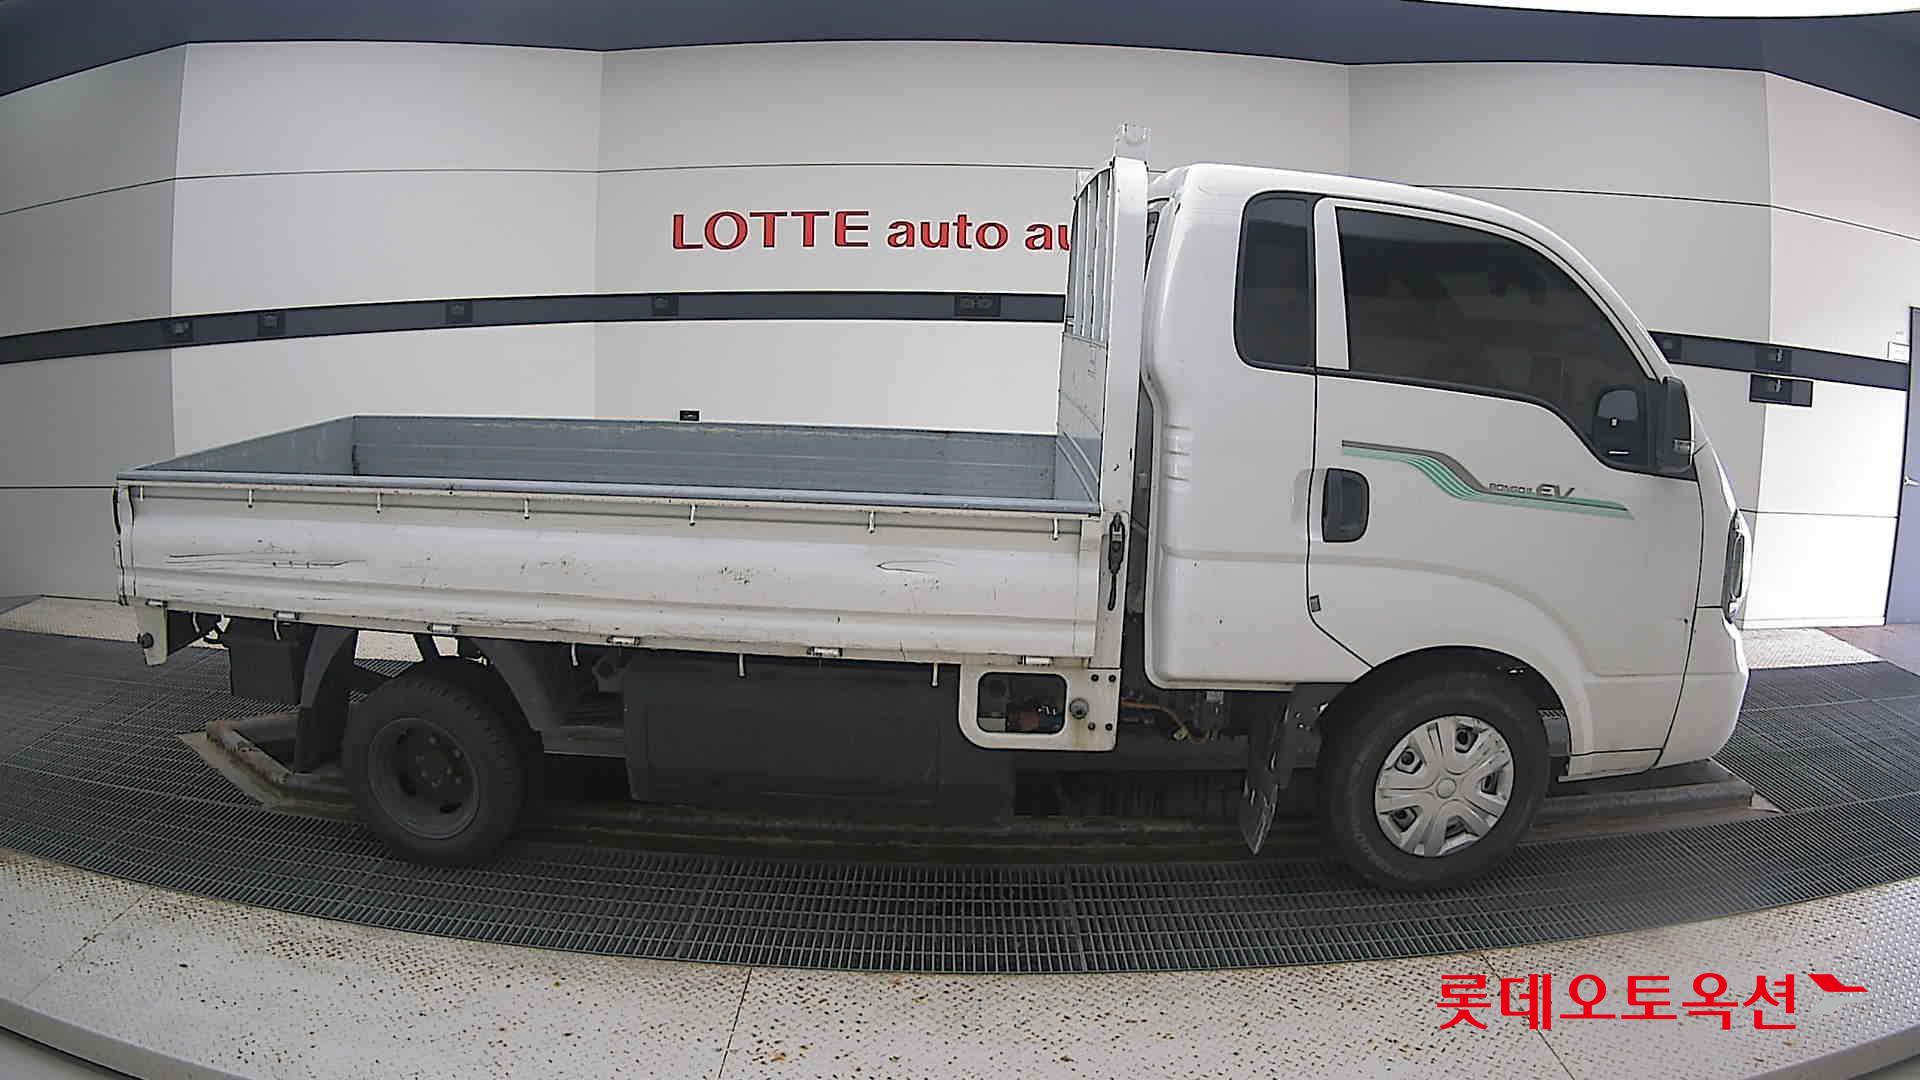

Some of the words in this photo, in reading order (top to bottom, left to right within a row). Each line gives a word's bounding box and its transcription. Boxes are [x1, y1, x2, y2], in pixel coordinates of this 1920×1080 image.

[672, 210, 870, 250] LOTTE
[887, 213, 1010, 249] auto
[1536, 483, 1576, 497] EV
